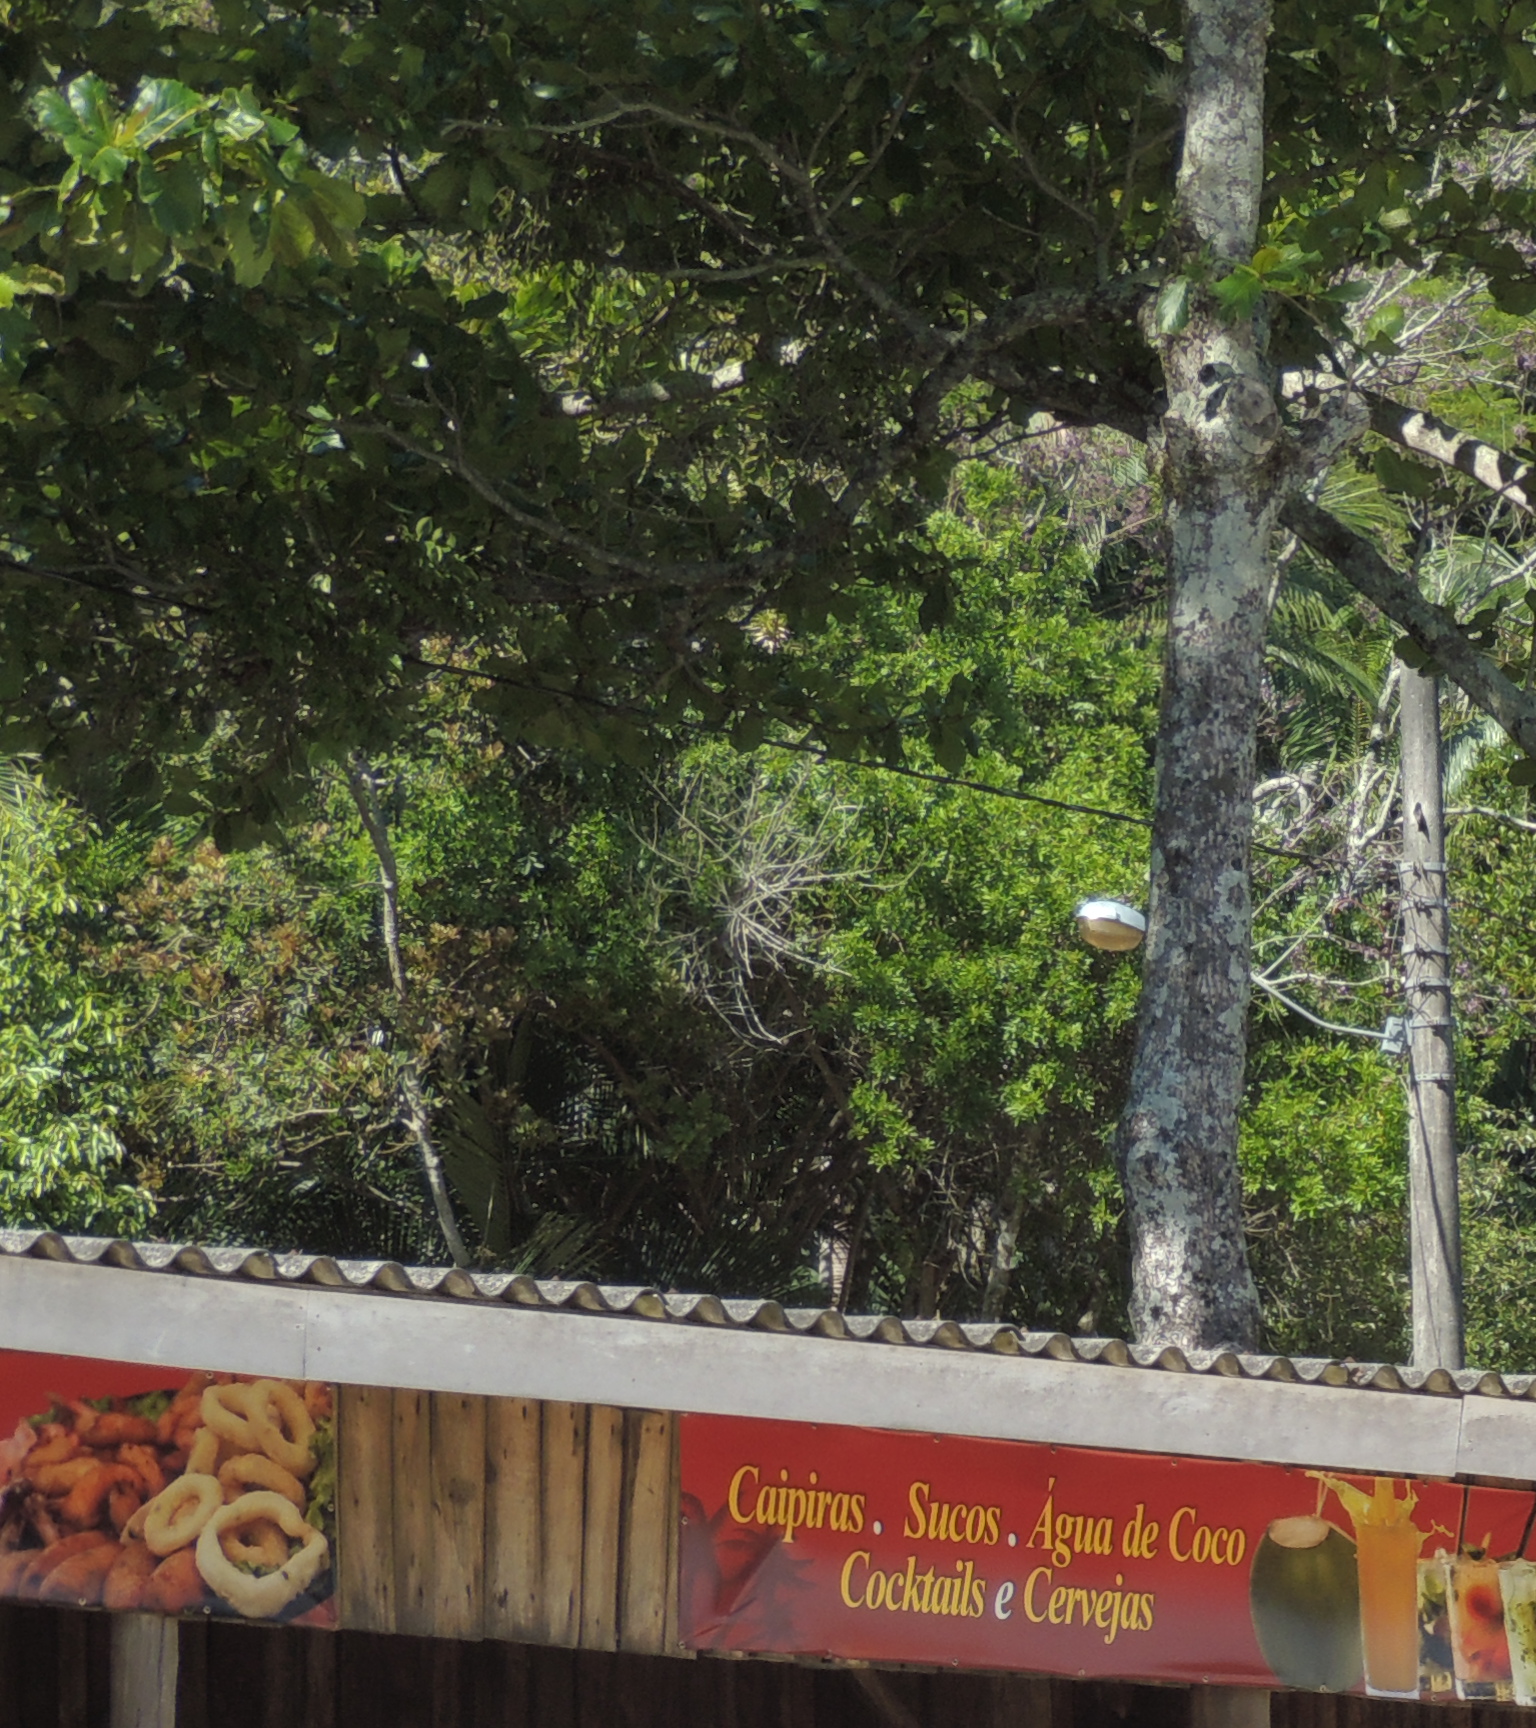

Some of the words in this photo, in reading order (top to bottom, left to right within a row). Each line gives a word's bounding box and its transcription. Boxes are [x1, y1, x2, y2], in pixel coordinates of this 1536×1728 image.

[728, 1465, 865, 1536] Caipiras
[904, 1480, 1000, 1537] Sucos
[1026, 1478, 1117, 1568] Água
[1121, 1505, 1158, 1561] de
[1168, 1508, 1245, 1566] Coco
[840, 1551, 985, 1618] Cocktails
[994, 1580, 1012, 1620] e
[1023, 1567, 1154, 1646] Cervejas
